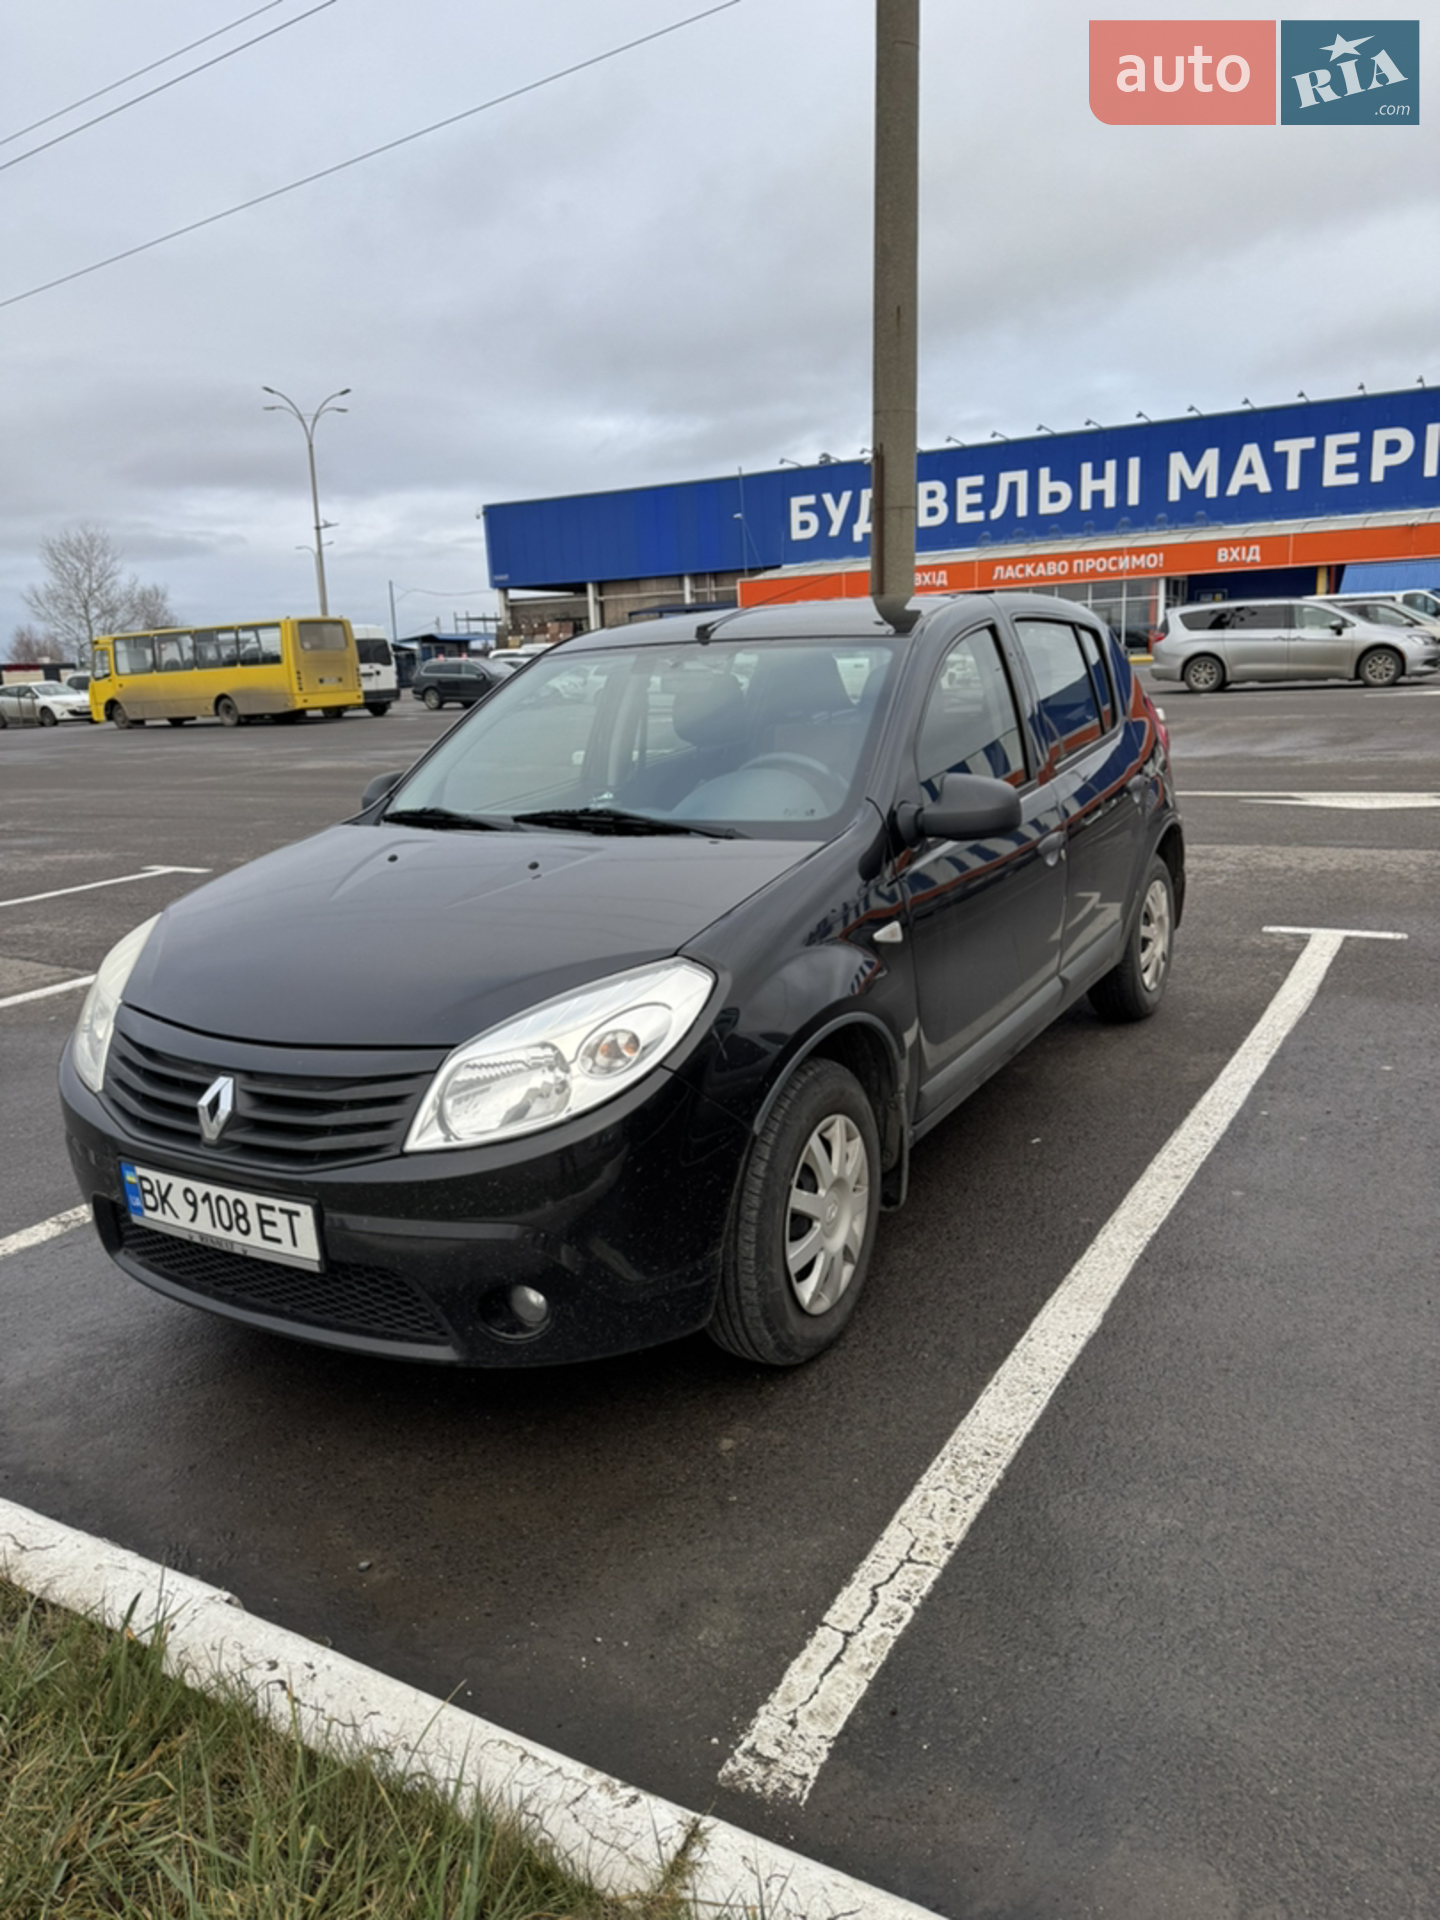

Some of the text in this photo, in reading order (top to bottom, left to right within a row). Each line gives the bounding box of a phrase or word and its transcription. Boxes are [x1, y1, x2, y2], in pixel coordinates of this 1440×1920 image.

[790, 456, 1141, 542] БУДВЕЛЬНІ
[992, 553, 1163, 581] ЛАСКАВО ПРОСИМО!
[1216, 545, 1261, 563] ВХІД
[138, 1175, 301, 1248] BK 9108 ET
